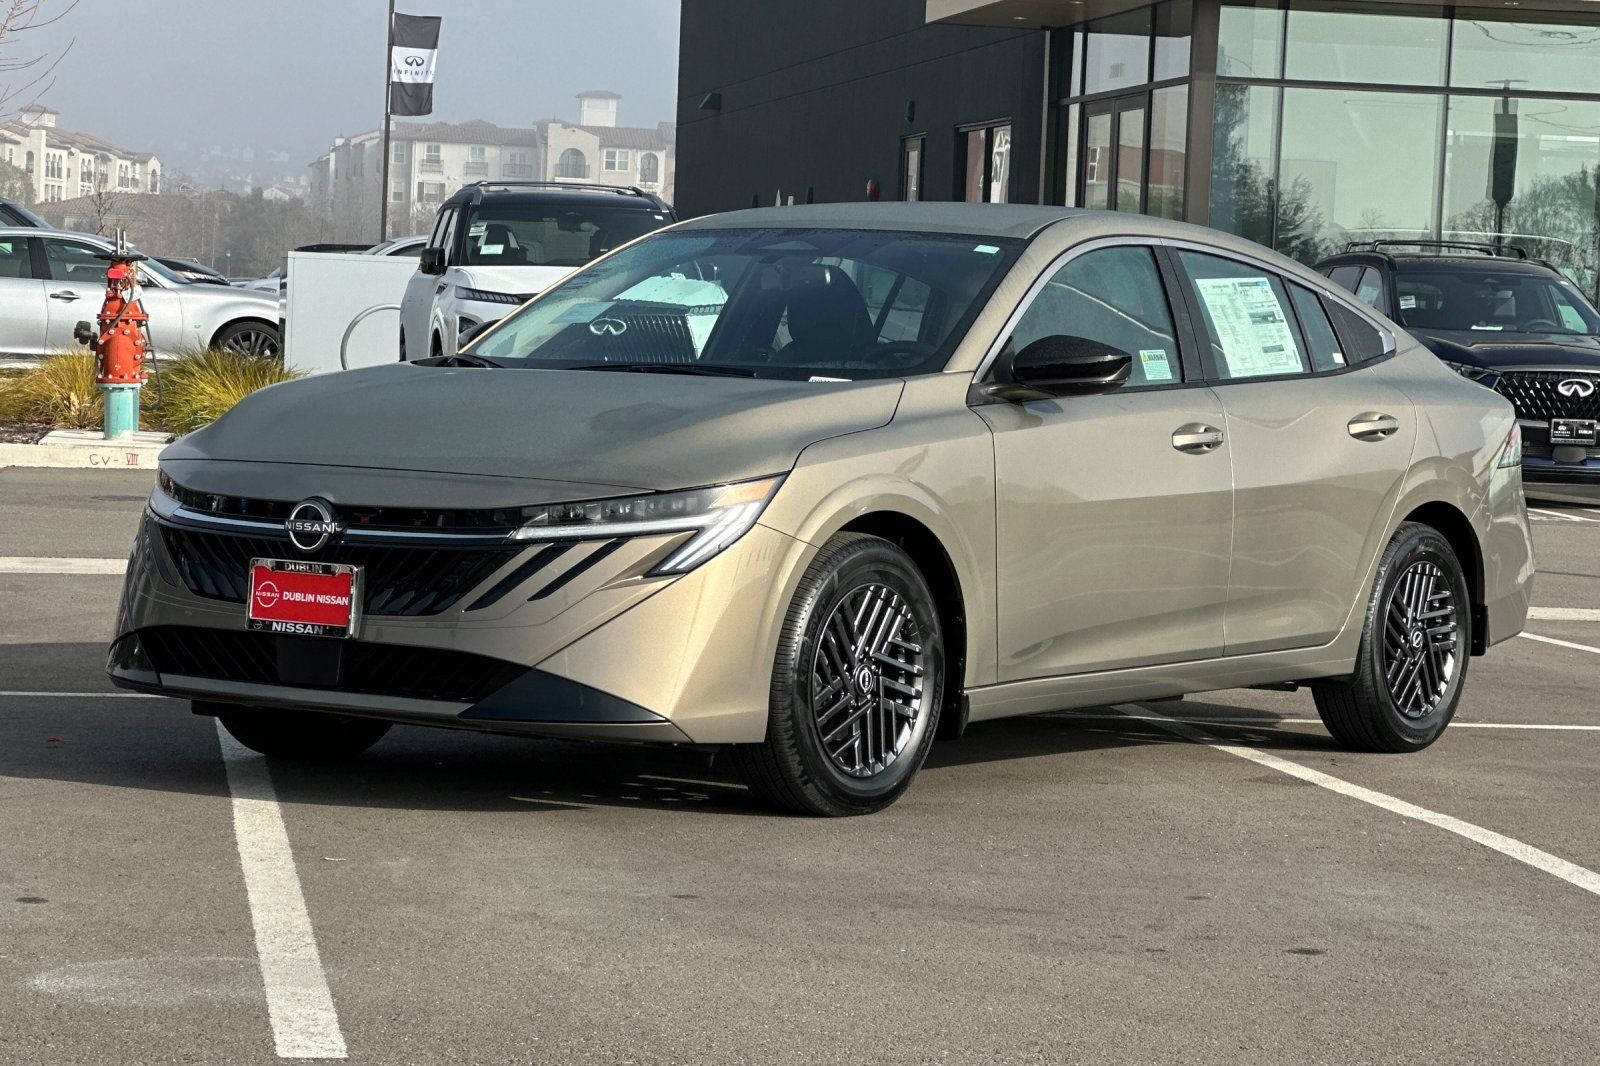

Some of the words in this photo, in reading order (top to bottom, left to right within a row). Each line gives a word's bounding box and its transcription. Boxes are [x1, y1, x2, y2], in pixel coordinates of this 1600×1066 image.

[284, 520, 332, 532] NISSAN
[284, 562, 323, 574] DUBLIN
[255, 590, 280, 598] NISSAN
[282, 591, 315, 603] DUBLIN
[316, 593, 349, 606] NISSAN
[271, 622, 324, 635] NISSAN
